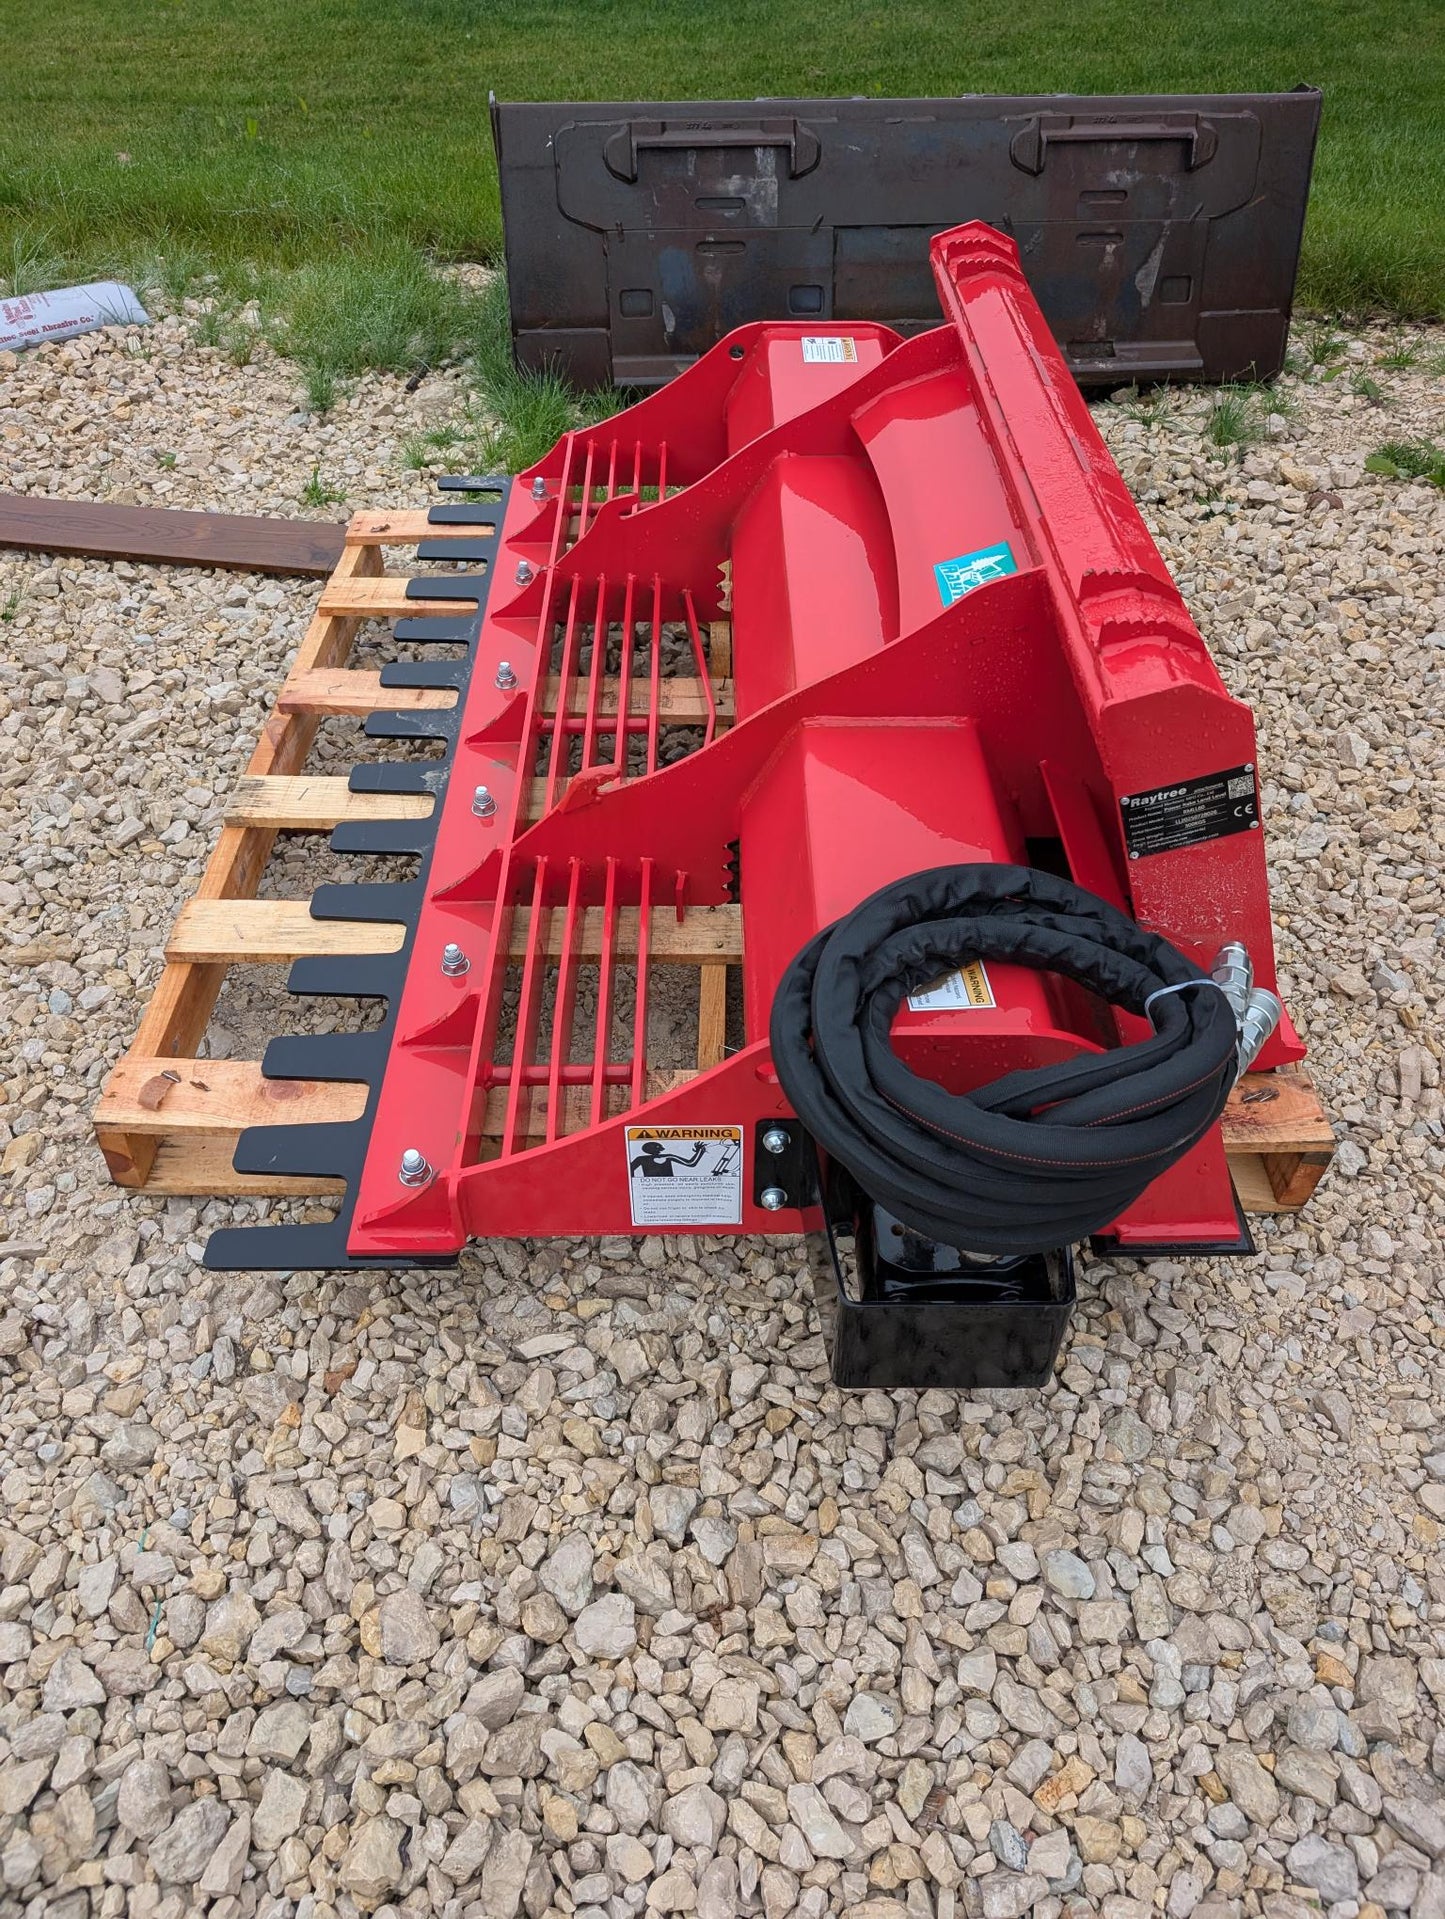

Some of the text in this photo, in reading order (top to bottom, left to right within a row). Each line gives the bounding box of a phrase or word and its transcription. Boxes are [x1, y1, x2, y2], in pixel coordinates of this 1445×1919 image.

[41, 319, 78, 332] Abrasive
[1130, 787, 1187, 808] Raytree
[967, 968, 985, 1003] WARNING
[655, 1129, 733, 1138] WARNING
